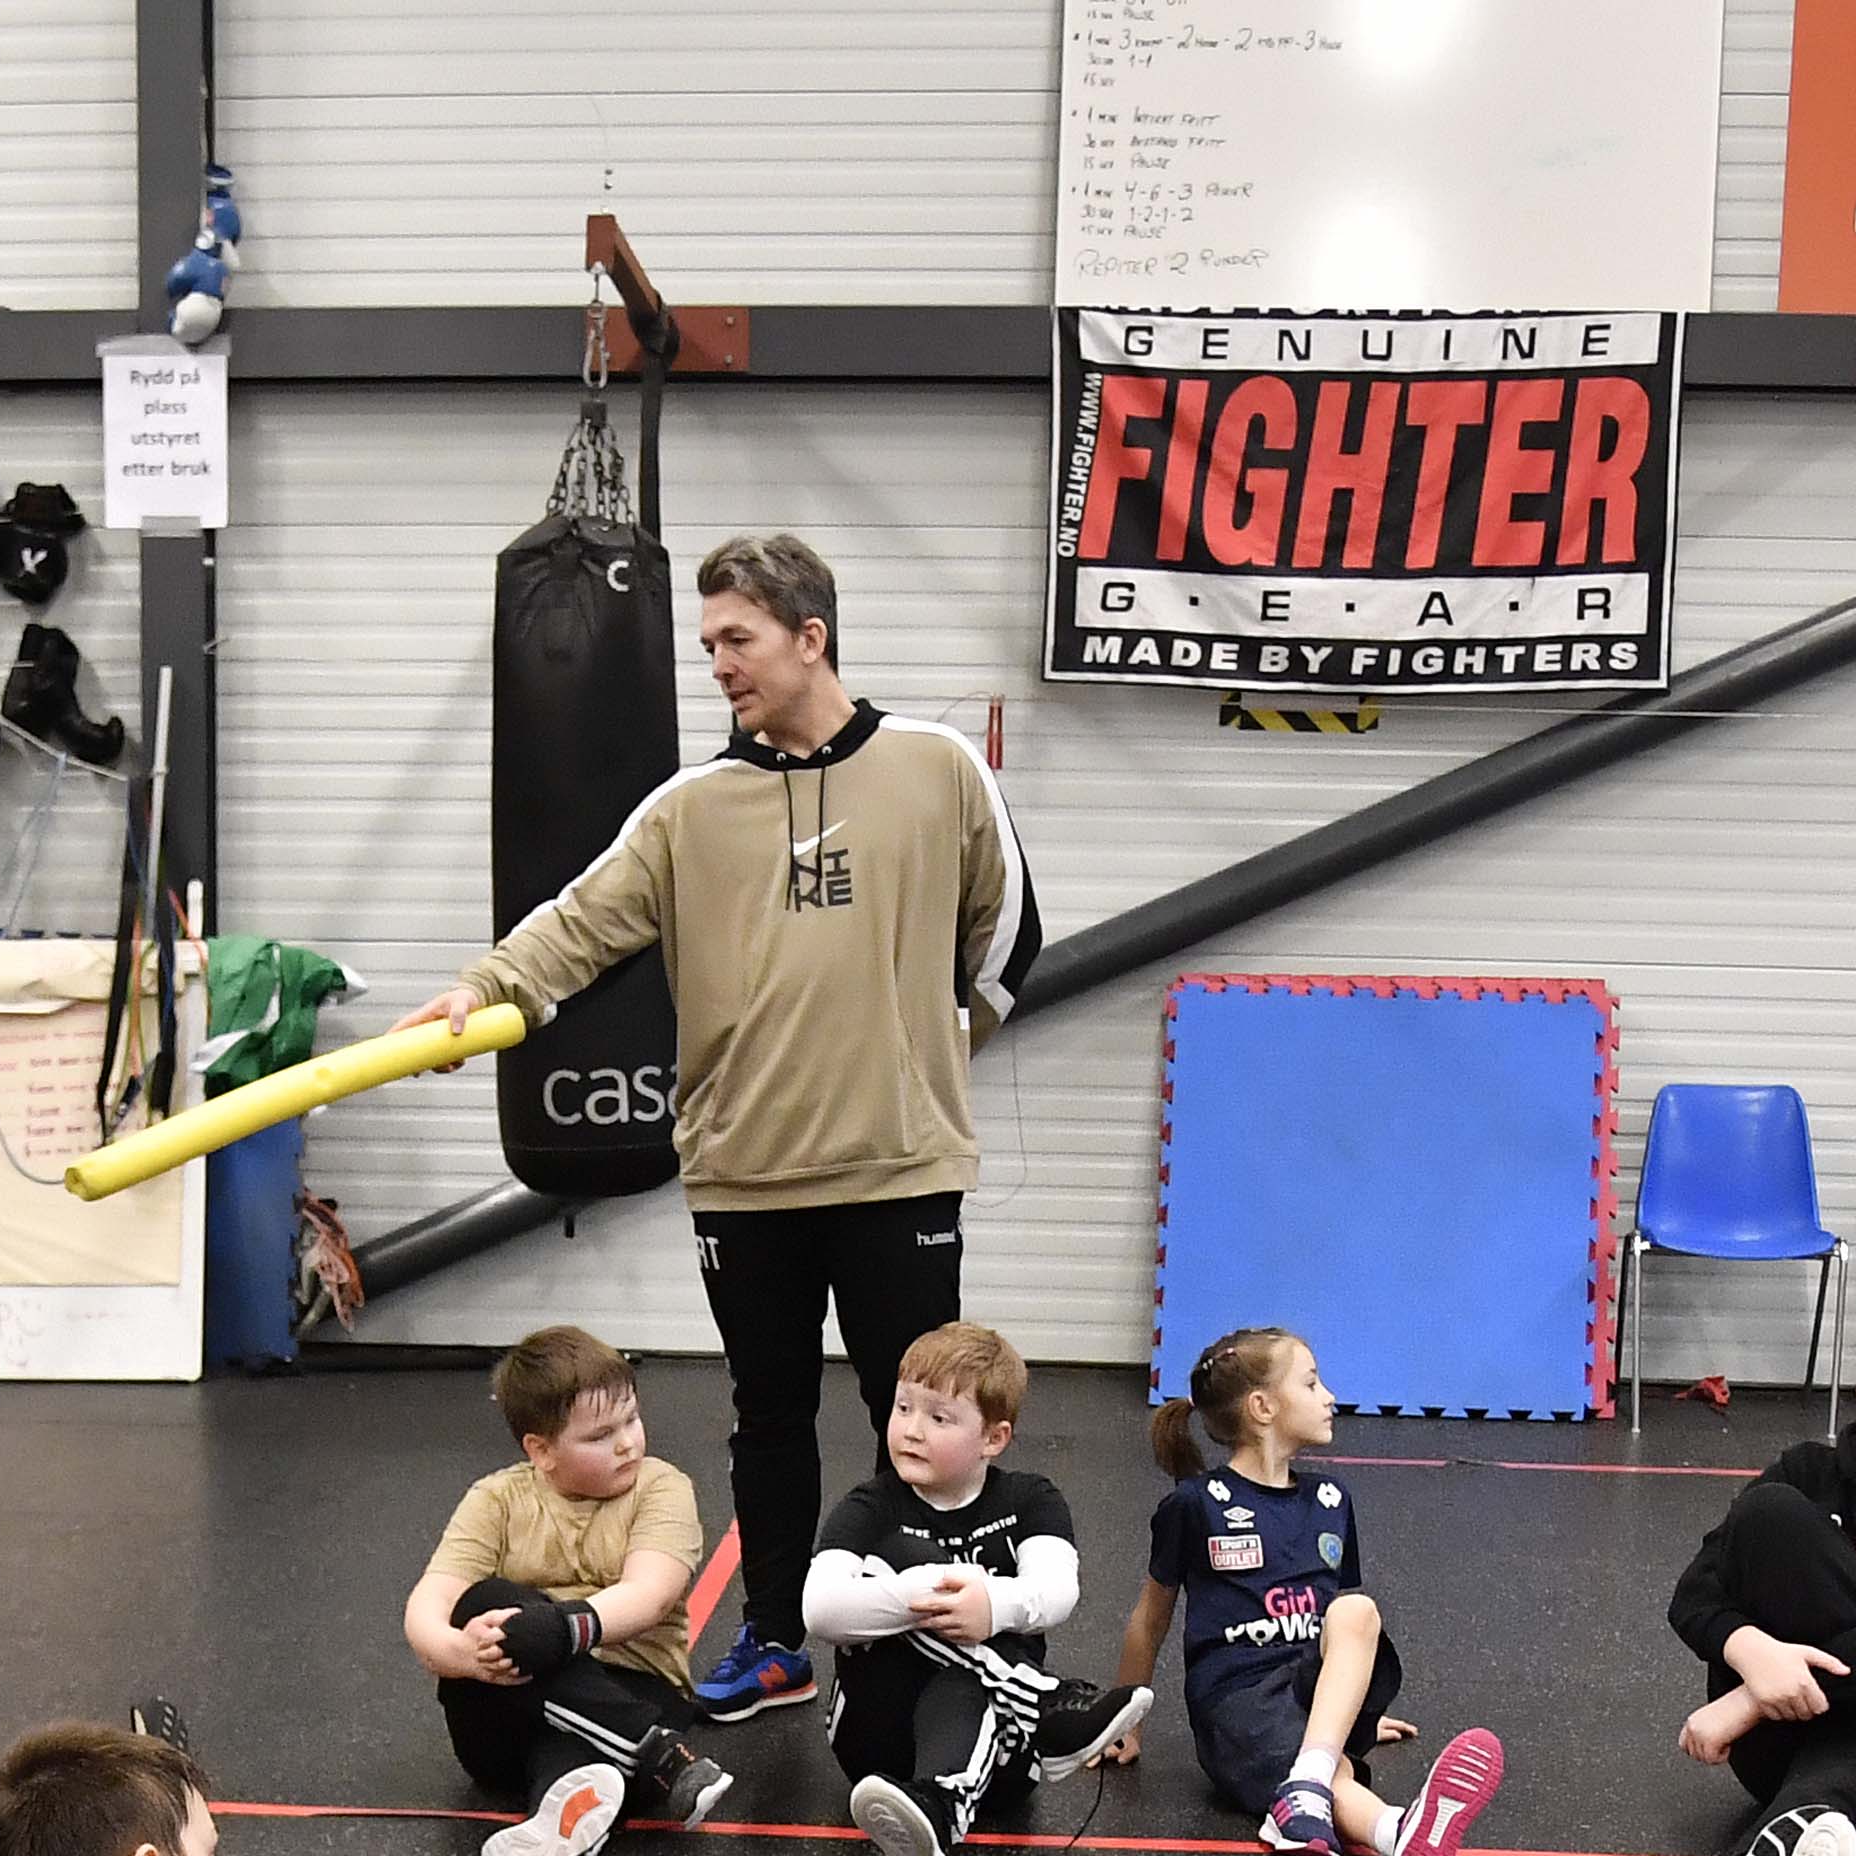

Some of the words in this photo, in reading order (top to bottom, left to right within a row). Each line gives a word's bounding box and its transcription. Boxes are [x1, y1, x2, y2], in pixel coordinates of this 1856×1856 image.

[1167, 251, 1191, 277] 2
[1123, 323, 1613, 364] GENUINE
[130, 369, 174, 388] Rydd
[180, 368, 201, 386] på
[144, 399, 187, 416] plass
[131, 432, 200, 448] utstyret
[122, 462, 164, 477] etter
[170, 460, 211, 476] bruk
[1057, 372, 1103, 559] WWW.FIGHTER.NO
[1077, 375, 1651, 569] FIGHTER
[1082, 635, 1239, 671] MADE
[1258, 645, 1333, 675] BY
[1350, 642, 1639, 676] FIGHTERS
[542, 1064, 678, 1126] cas
[1214, 1551, 1259, 1568] OUTLET
[1264, 1585, 1317, 1619] Girl
